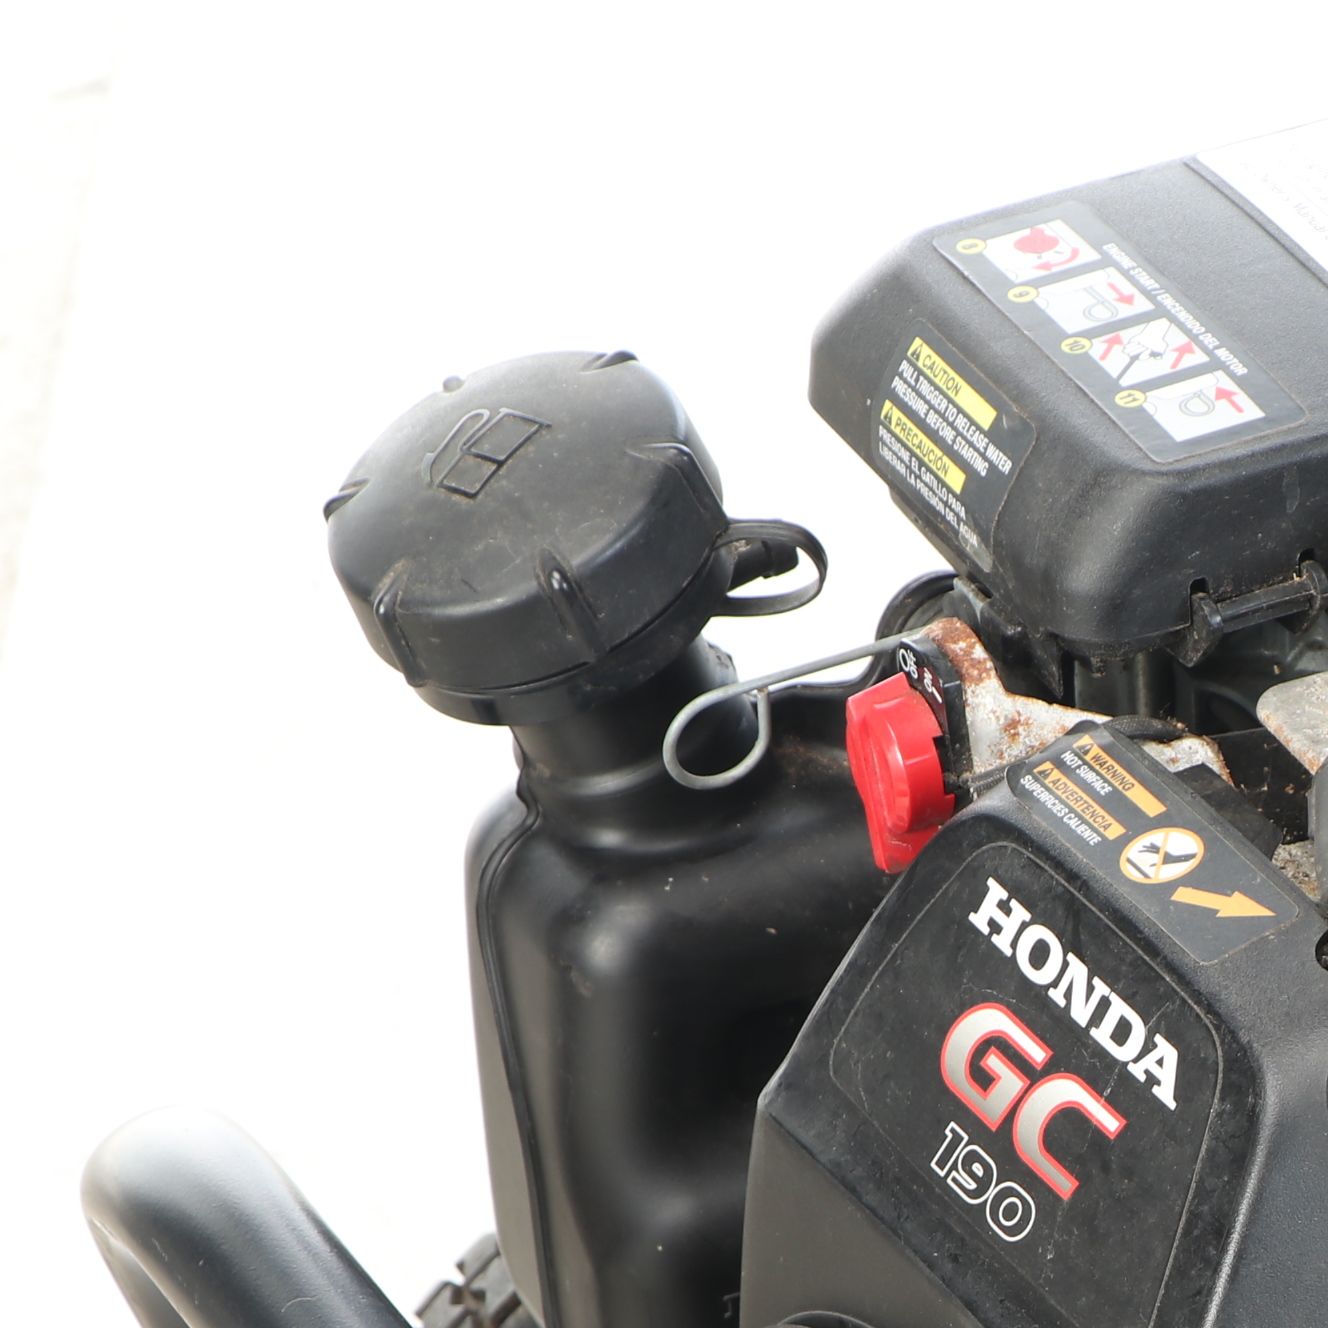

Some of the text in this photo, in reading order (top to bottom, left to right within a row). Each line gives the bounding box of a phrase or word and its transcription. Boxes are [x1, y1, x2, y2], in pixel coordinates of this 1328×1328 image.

[1102, 242, 1250, 377] ENGINE START ENCENDIDO DEL MOTOR
[922, 353, 961, 397] CAUTION
[1067, 339, 1087, 352] 10
[891, 375, 988, 476] PRESSURE BEFORE STARTING
[898, 359, 1012, 474] PULL TRIGGER TO RELEASE WATER
[1119, 393, 1141, 405] 11
[895, 418, 950, 477] PRECAUCIÓN
[910, 456, 922, 475] EL
[920, 466, 949, 501] GATILLO
[947, 492, 966, 520] PARA
[945, 503, 962, 529] DEL
[1060, 750, 1112, 795] HOT SURFACE
[1089, 752, 1134, 791] WARNING
[1020, 774, 1101, 845] SUPERFICIES CALIENTE
[1050, 777, 1113, 832] ADVERTENCIA
[968, 876, 1179, 1112] HONDA
[940, 1002, 1127, 1201] GC
[930, 1121, 1036, 1242] 190
